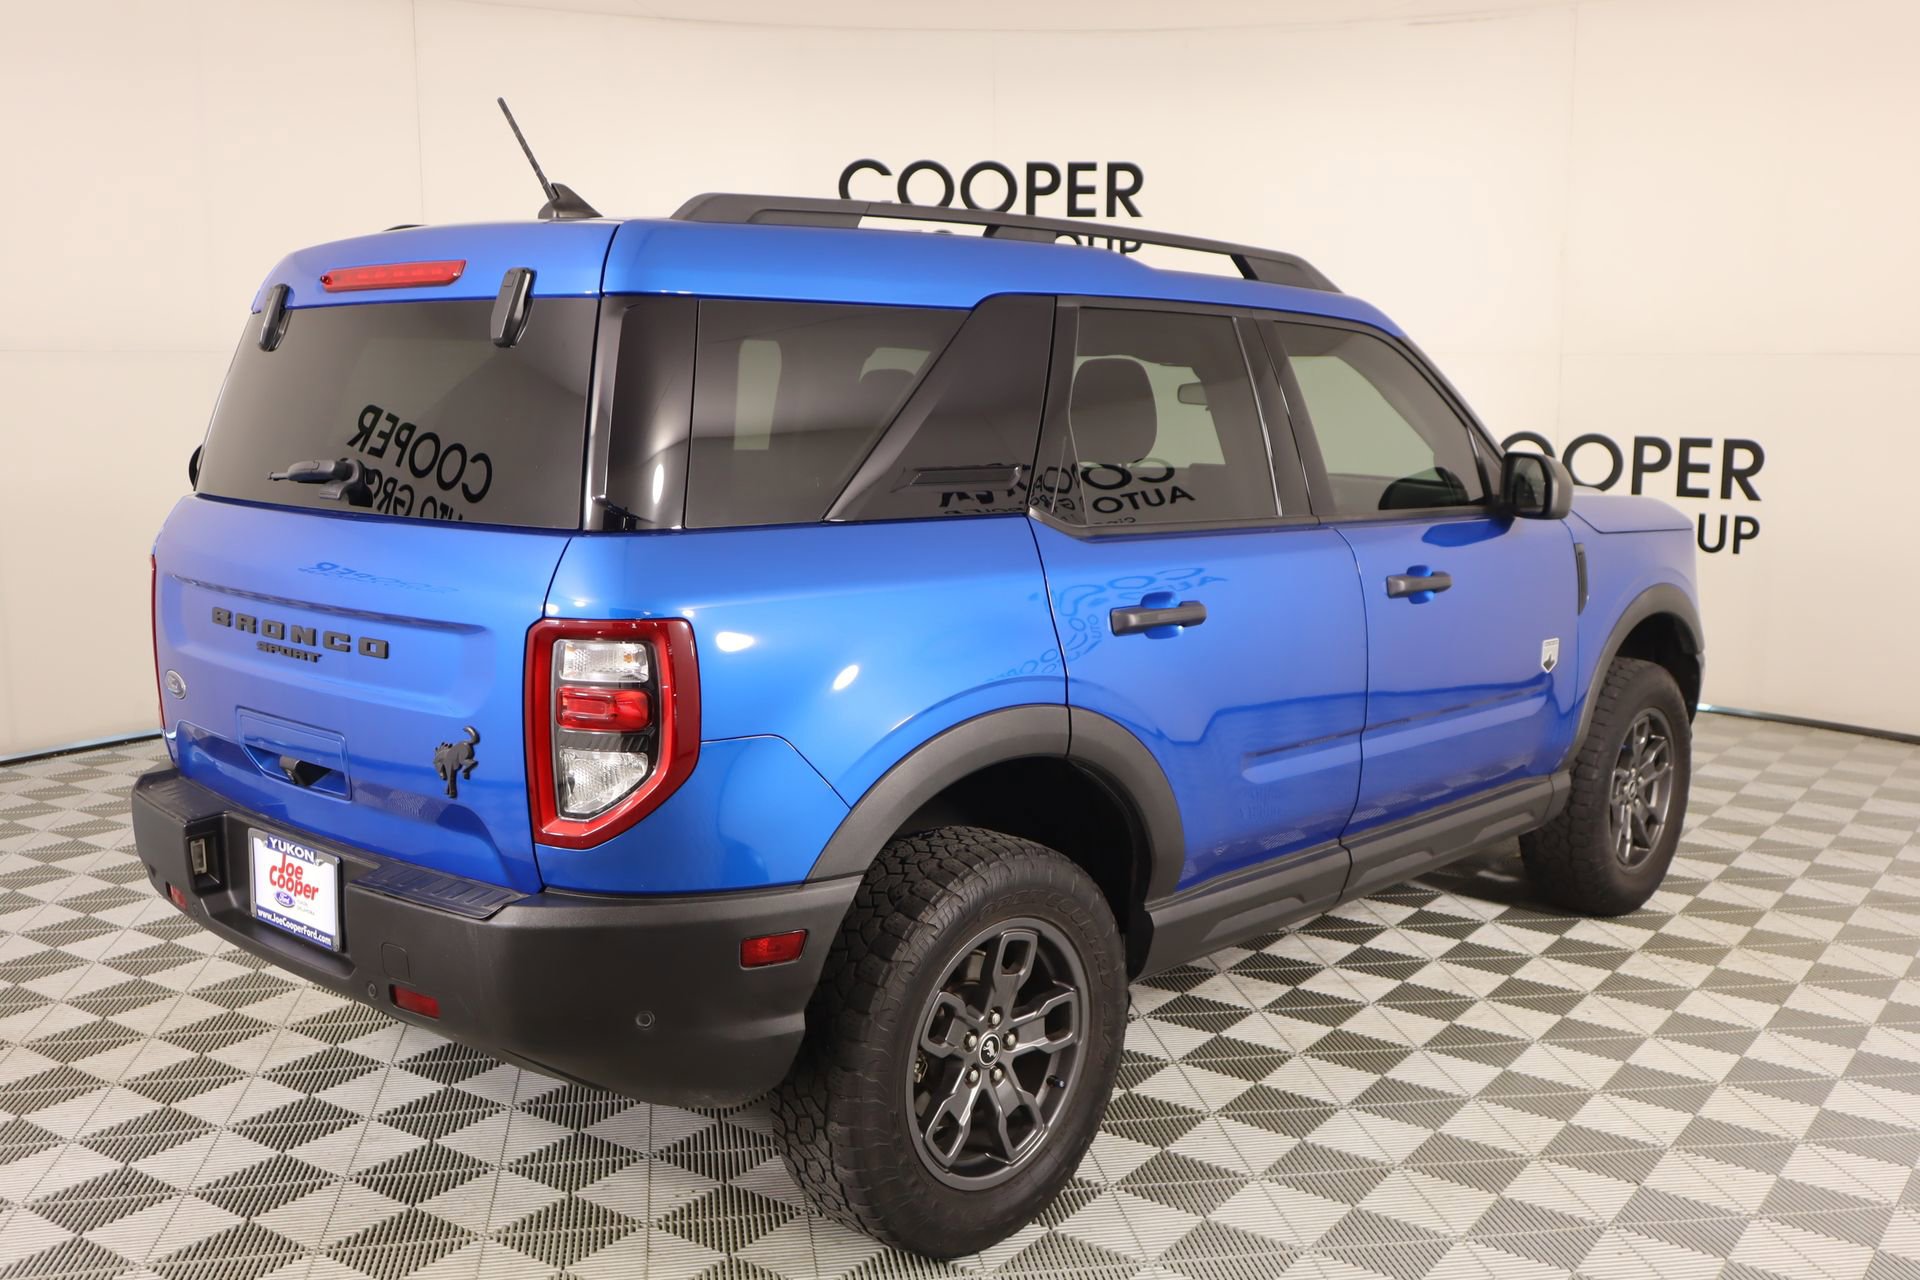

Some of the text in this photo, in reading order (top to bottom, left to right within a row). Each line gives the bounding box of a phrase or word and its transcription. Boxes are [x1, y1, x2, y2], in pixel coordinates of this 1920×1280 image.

[838, 158, 1144, 217] COOPER
[212, 606, 389, 659] BRONCO
[256, 640, 323, 663] SPORT
[268, 837, 315, 863] YUKON
[278, 854, 303, 880] Joe
[269, 865, 319, 900] Cooper
[257, 908, 332, 946] www.JoeCooperFord.com
